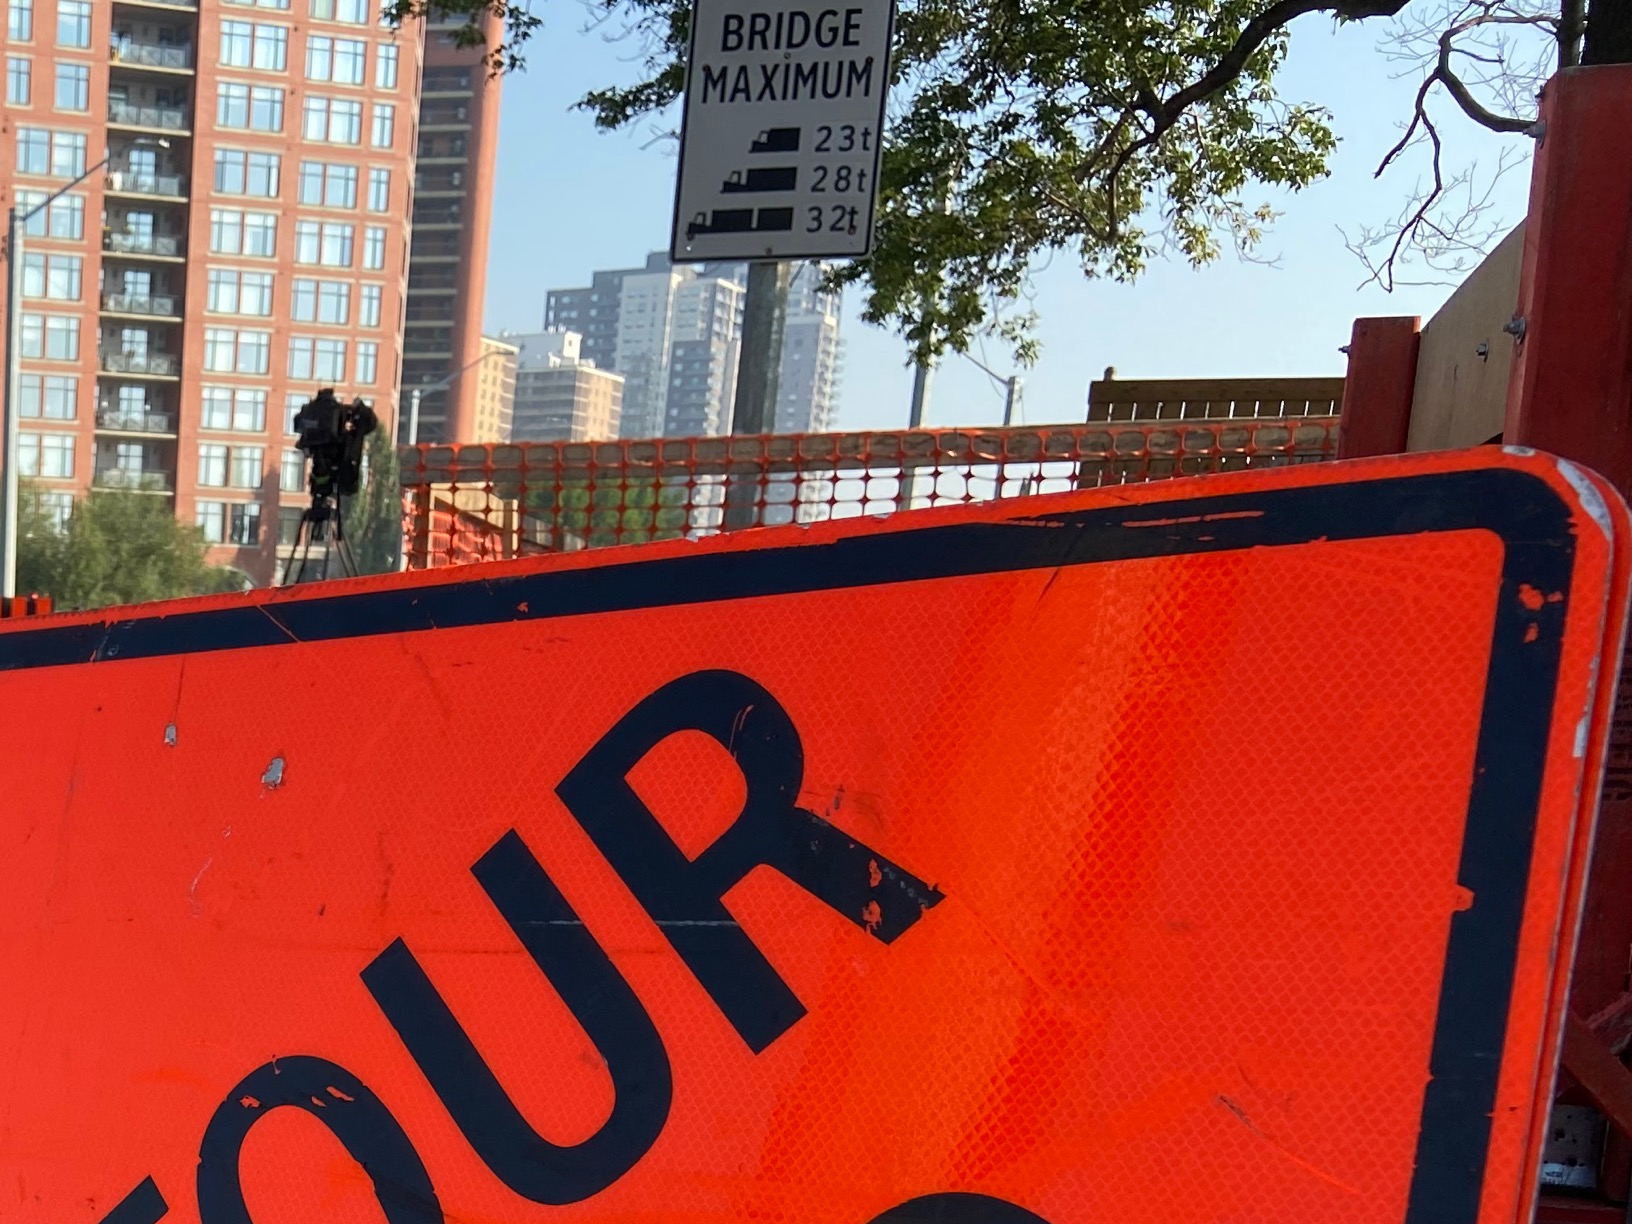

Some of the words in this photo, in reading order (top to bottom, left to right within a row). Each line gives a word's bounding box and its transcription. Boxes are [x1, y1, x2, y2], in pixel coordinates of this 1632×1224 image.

[721, 8, 863, 52] BRIDGE
[701, 57, 874, 104] MAXIMUM
[814, 124, 872, 153] 23t
[810, 165, 866, 193] 28t
